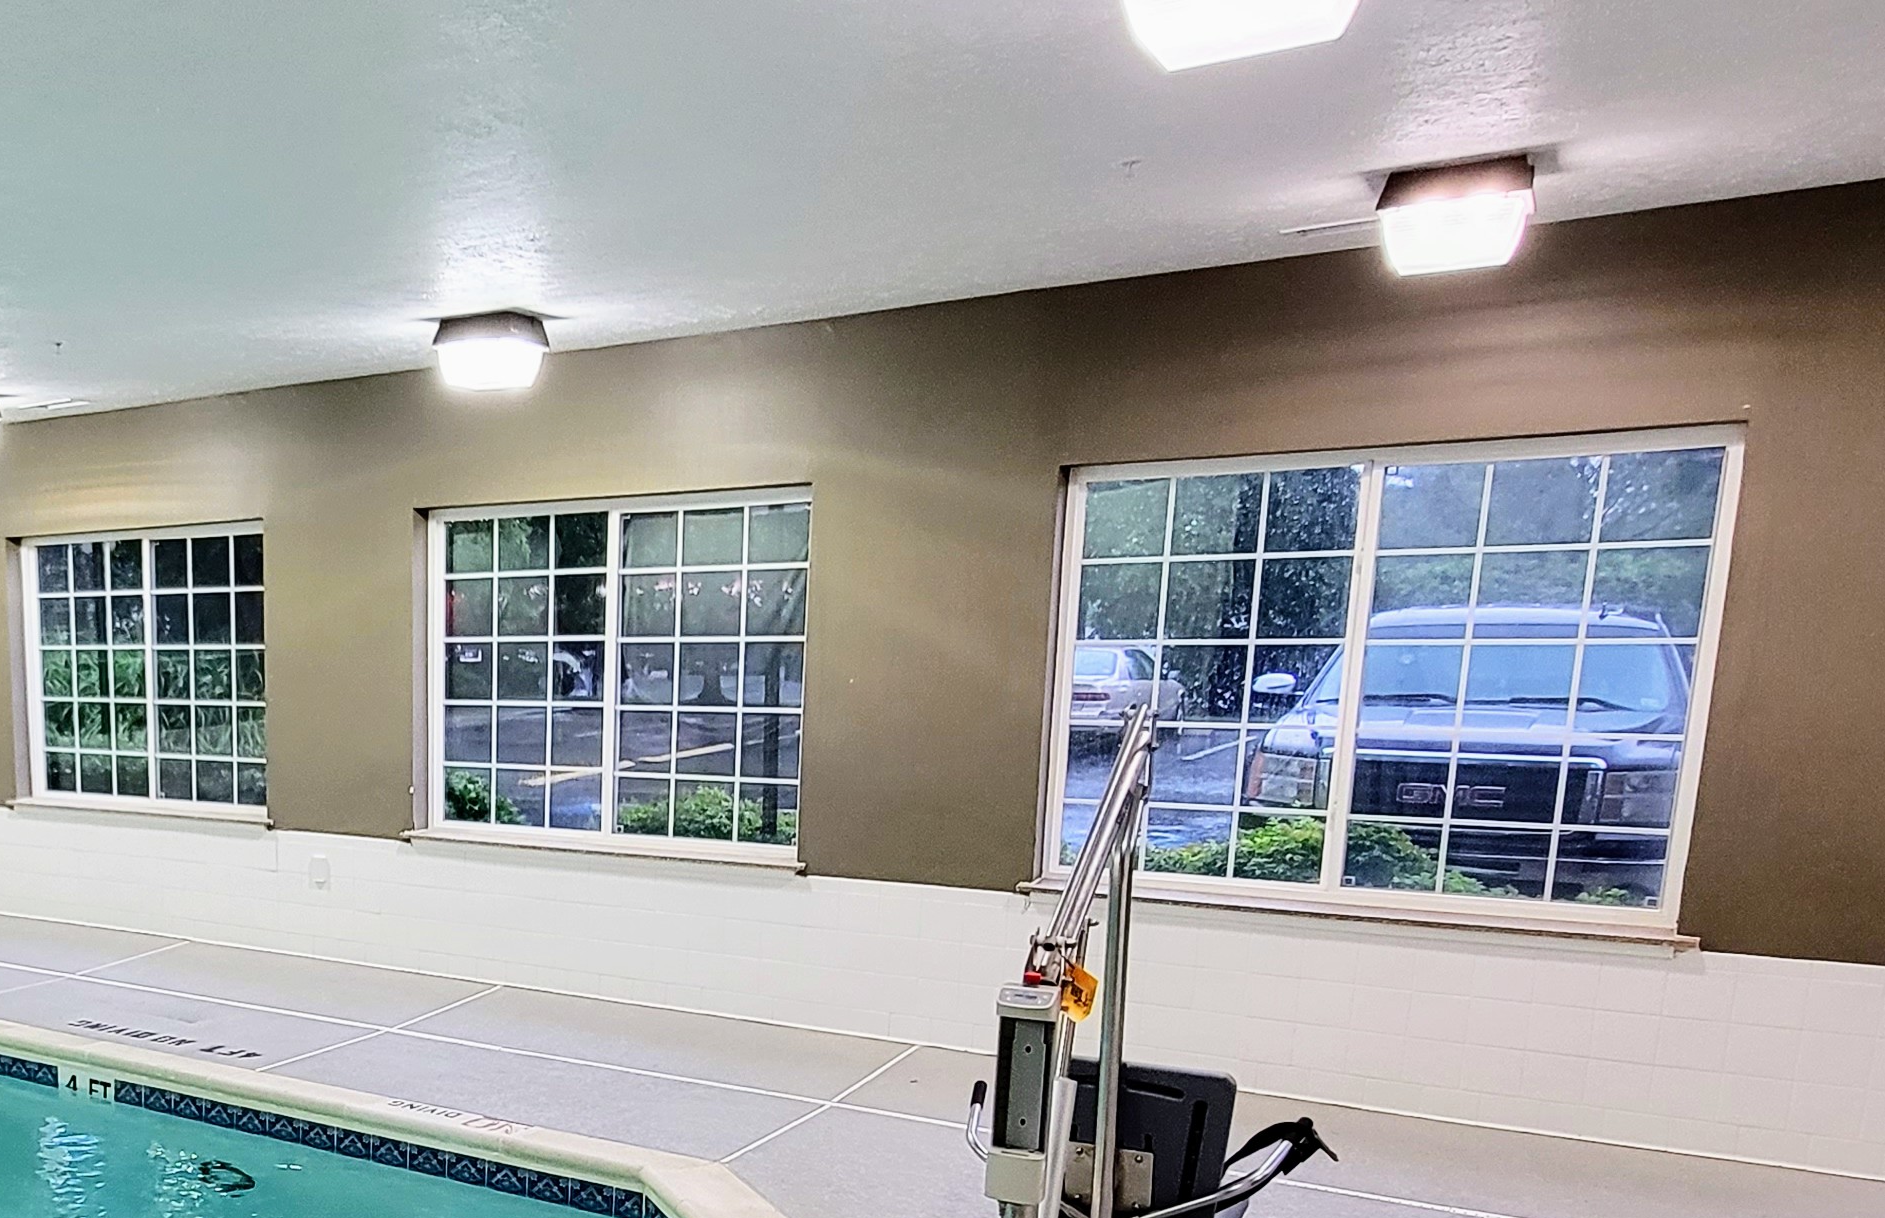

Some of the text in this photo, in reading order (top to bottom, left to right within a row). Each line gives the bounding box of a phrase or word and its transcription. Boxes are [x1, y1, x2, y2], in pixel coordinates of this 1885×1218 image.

[1395, 782, 1506, 808] GMC
[200, 1044, 262, 1060] 4FT
[65, 1074, 112, 1099] 4 FT
[388, 1100, 463, 1119] DIVING
